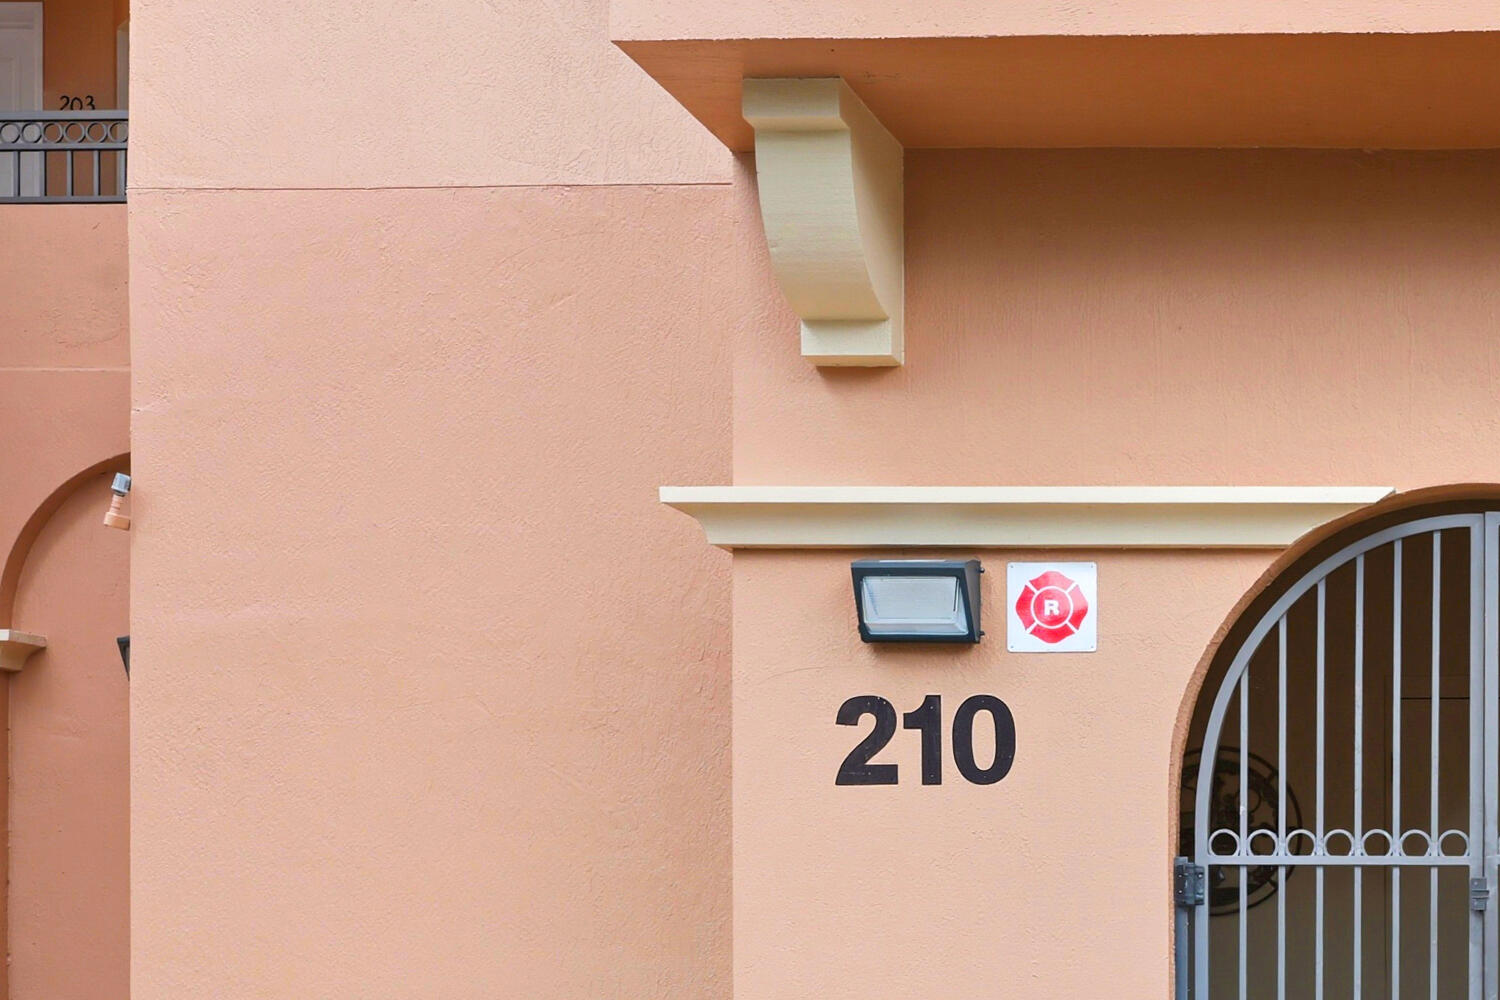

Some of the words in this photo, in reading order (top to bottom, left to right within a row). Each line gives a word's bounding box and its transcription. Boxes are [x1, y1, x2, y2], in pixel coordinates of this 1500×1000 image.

[60, 95, 95, 111] 203
[1043, 599, 1060, 616] R
[835, 694, 1016, 785] 210
